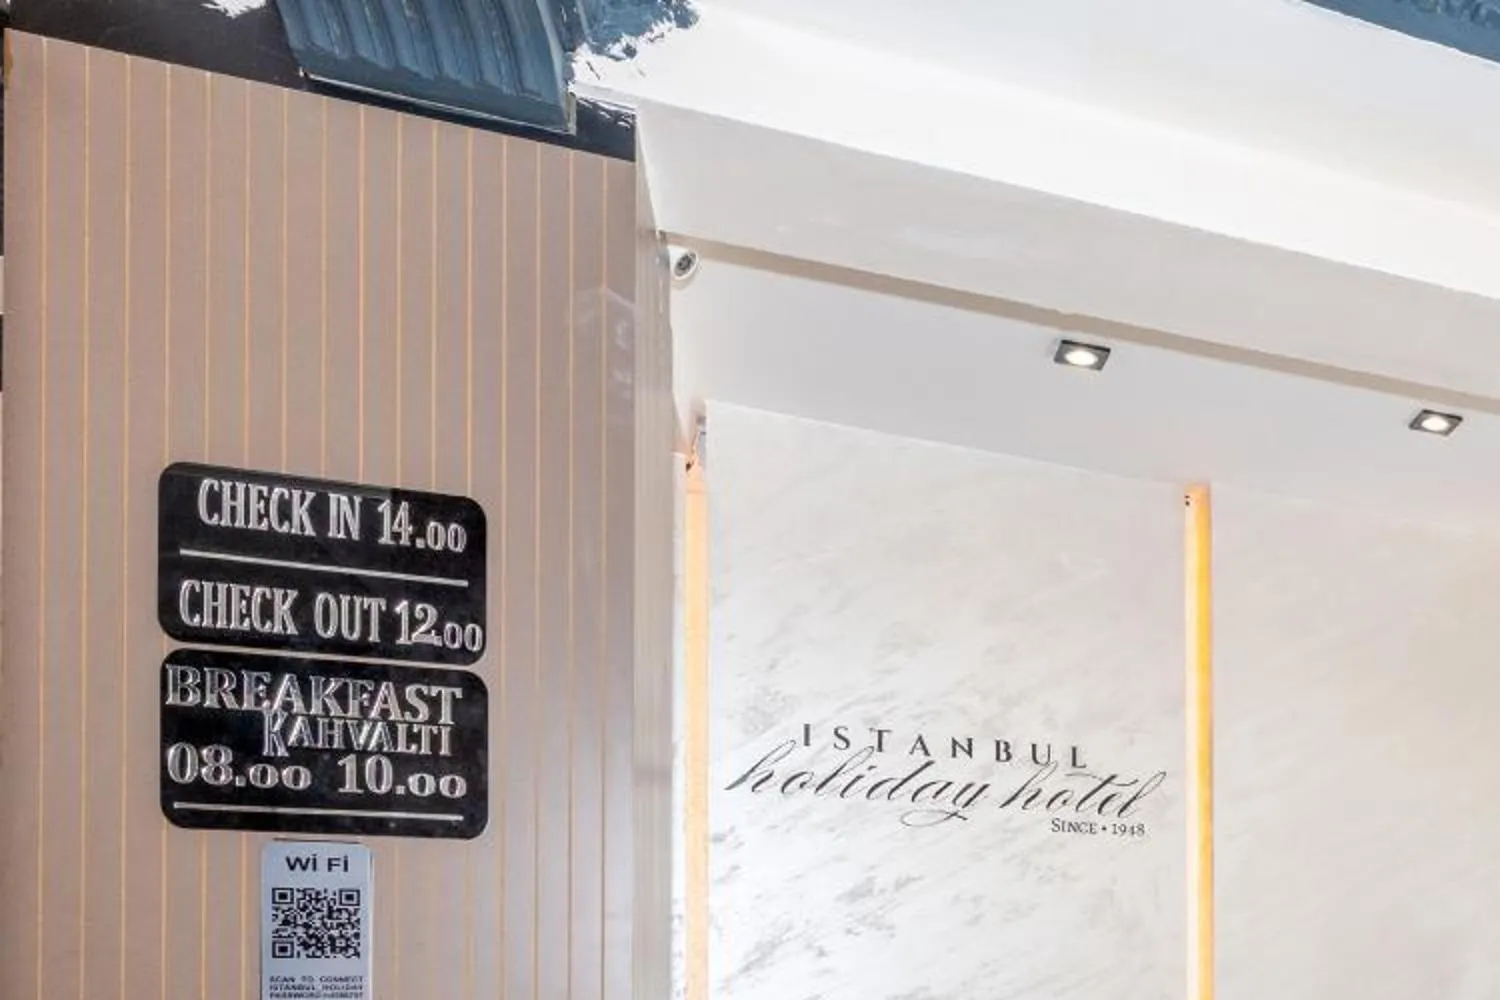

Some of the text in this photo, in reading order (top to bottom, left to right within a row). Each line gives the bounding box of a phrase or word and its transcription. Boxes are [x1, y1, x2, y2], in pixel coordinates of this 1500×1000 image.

[198, 477, 468, 553] CHECK IN 14.00
[179, 579, 484, 652] CHECK OUT 12.00
[165, 664, 463, 725] BREAKFAST
[263, 709, 453, 756] KAHVALTI
[802, 723, 1086, 768] ISTANBUL
[167, 742, 468, 799] 08.00 10.00
[724, 739, 1167, 827] holiday hotel
[1111, 823, 1146, 837] 1948
